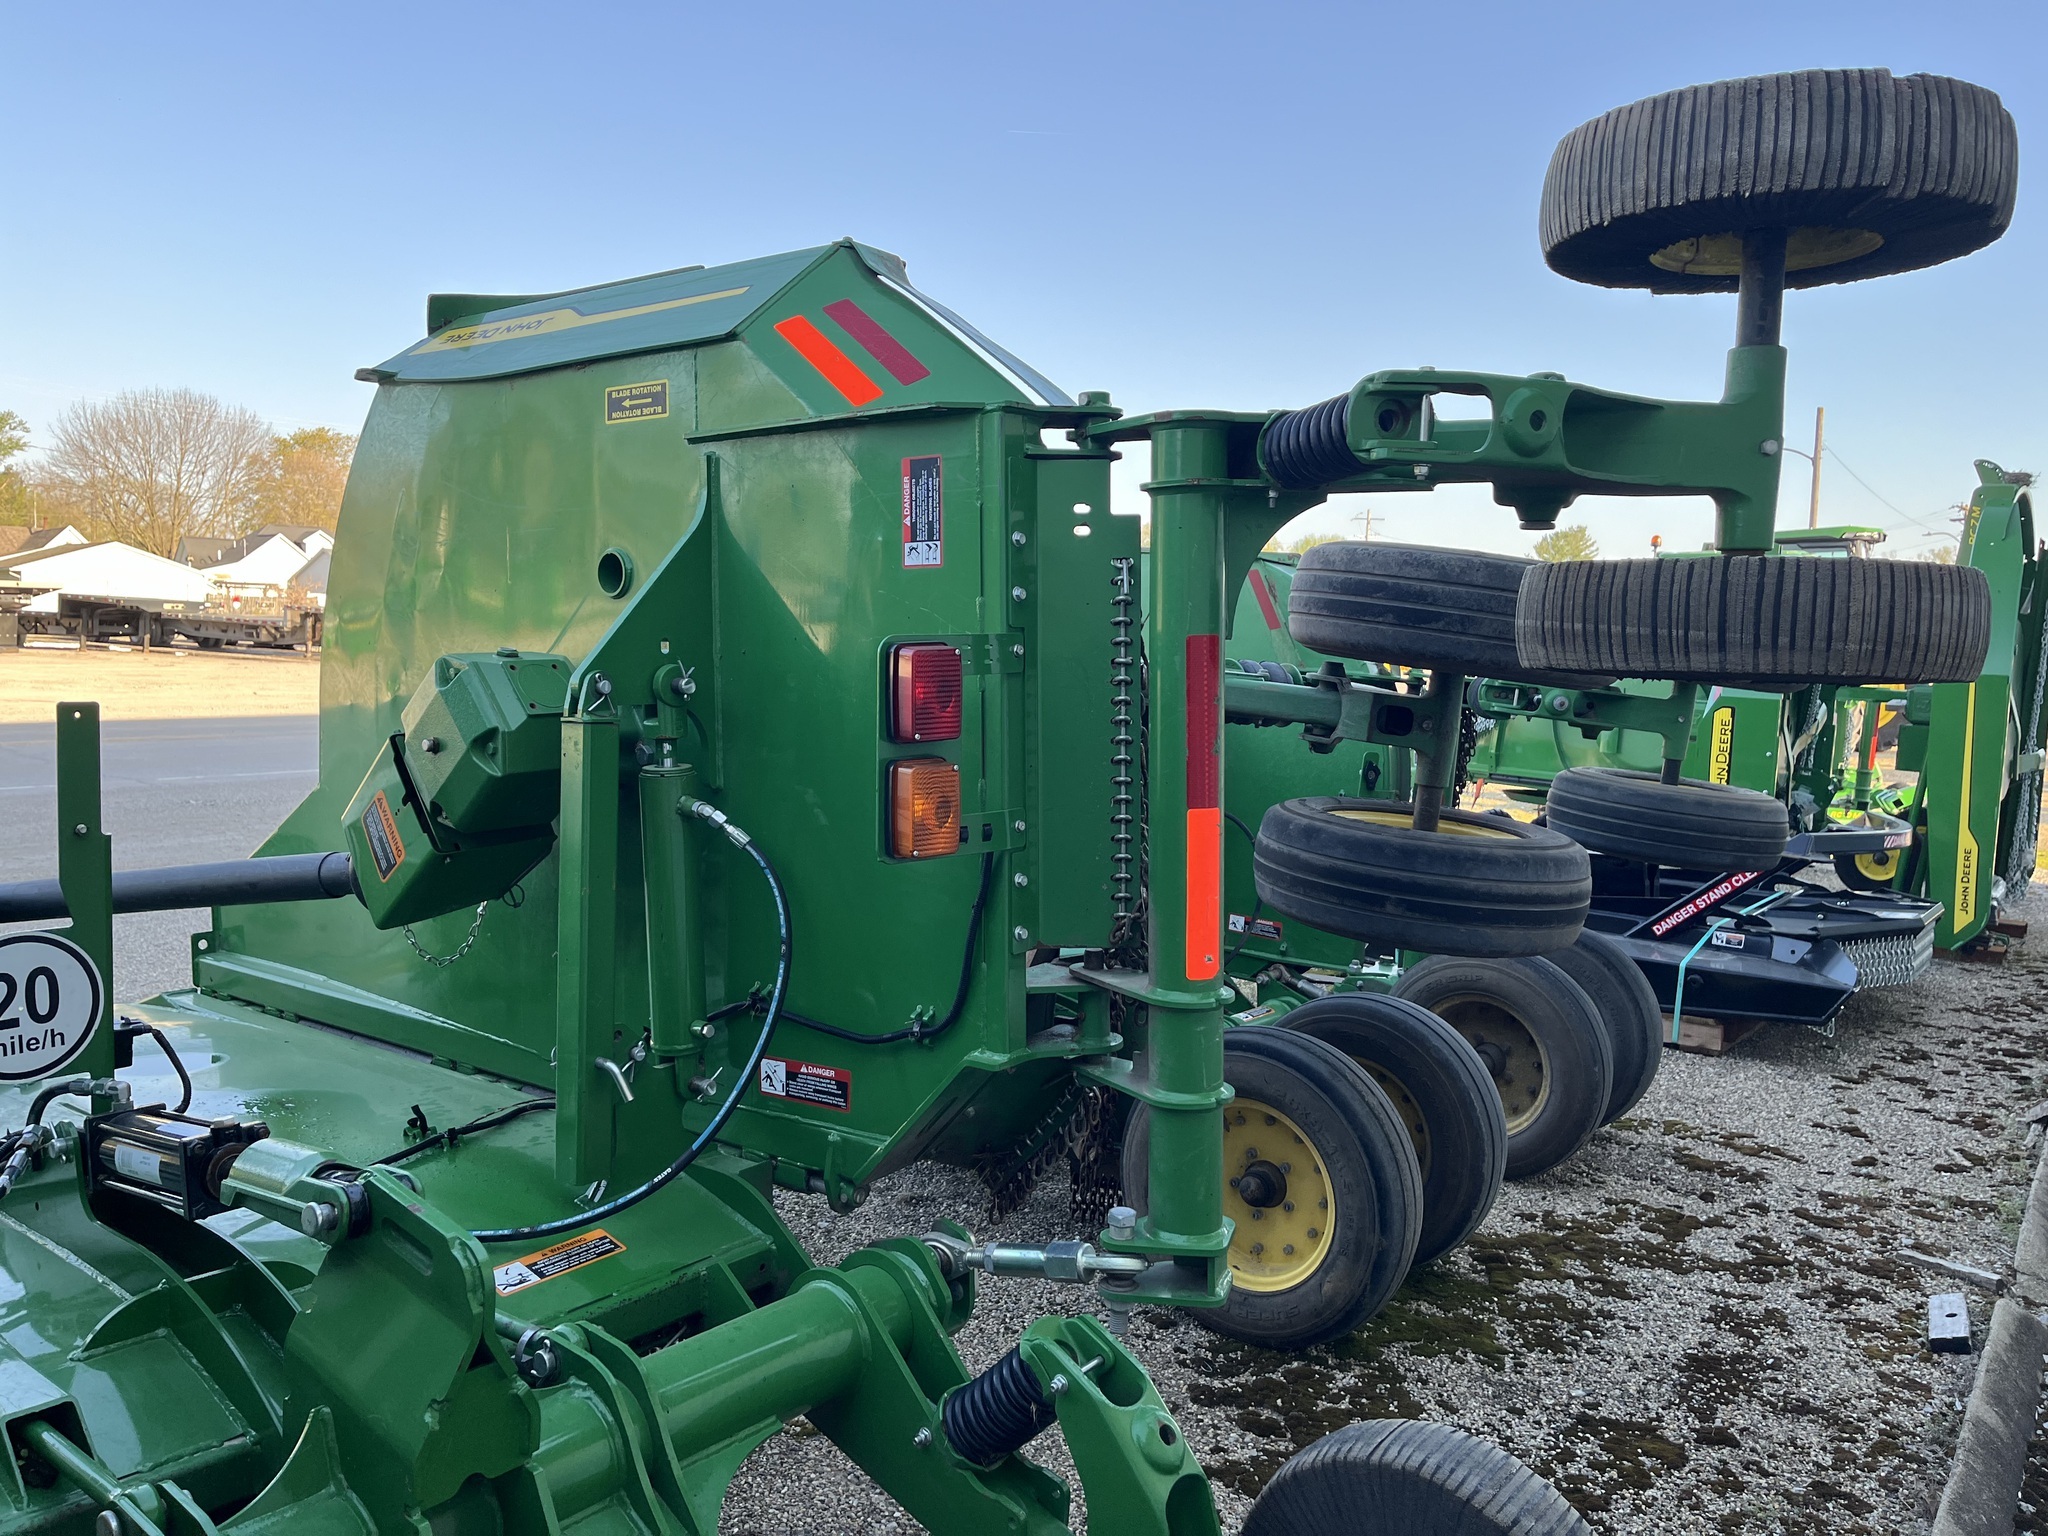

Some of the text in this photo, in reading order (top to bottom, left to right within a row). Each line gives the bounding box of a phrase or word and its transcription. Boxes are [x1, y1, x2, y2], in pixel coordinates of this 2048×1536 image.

[440, 316, 554, 344] JOHN DEERE
[611, 384, 662, 398] BLADE ROTATION
[611, 406, 662, 419] BLADE ROTATION
[1715, 719, 1731, 785] HN DEERE
[381, 805, 402, 857] WARNING
[1960, 848, 1972, 915] JOHN DEERE
[1652, 871, 1758, 936] DANGER STAND CLE
[0, 966, 60, 1025] 20
[807, 1066, 835, 1077] DANGER
[549, 1236, 587, 1254] WARNING
